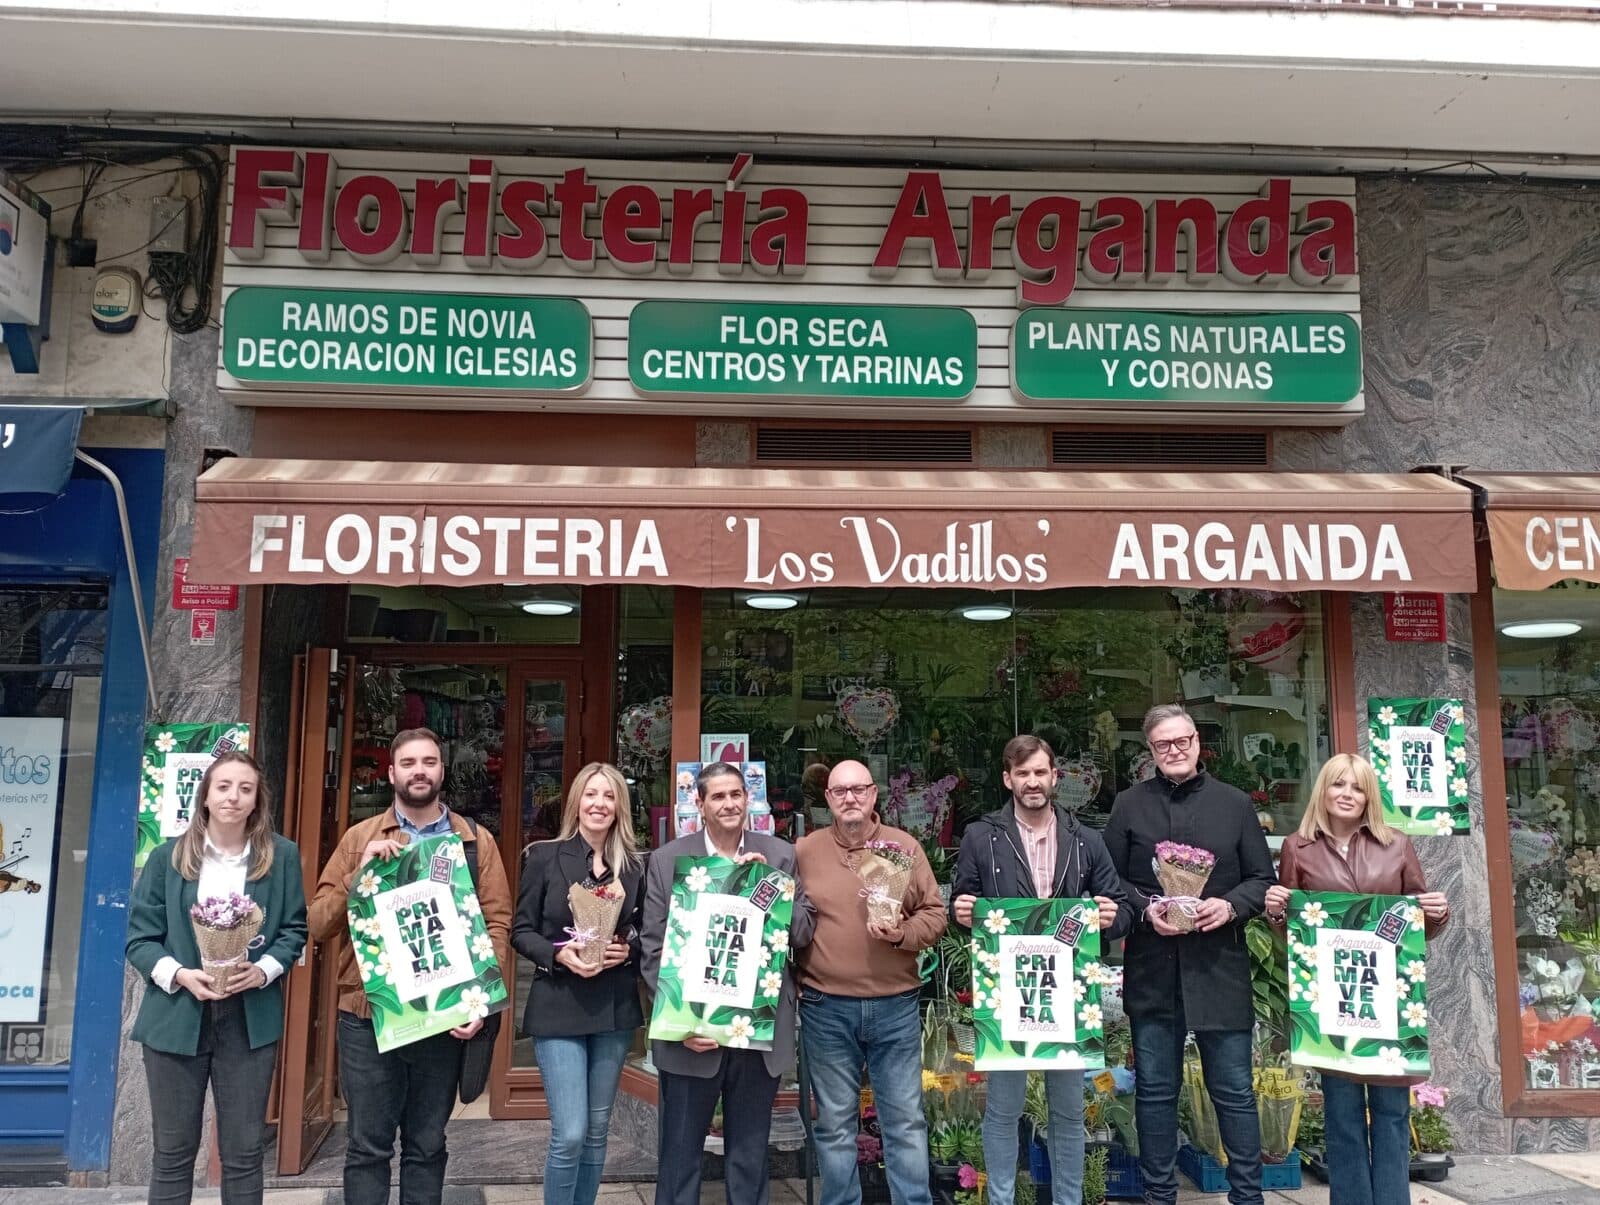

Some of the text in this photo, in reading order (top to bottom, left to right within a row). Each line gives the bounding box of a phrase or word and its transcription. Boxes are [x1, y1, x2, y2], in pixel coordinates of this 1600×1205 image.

[228, 153, 1355, 306] Floristería Arganda
[282, 302, 537, 340] RAMOS DE NOVIA
[721, 315, 889, 348] FLOR SECA
[1028, 322, 1346, 355] PLANTAS NATURALES
[237, 338, 577, 379] DECORACION IGLESIAS
[642, 349, 964, 387] CENTROS Y TARRINAS
[1101, 359, 1274, 390] Y CORONAS
[249, 514, 669, 577] FLORISTERIA
[1108, 523, 1412, 582] ARGANDA
[1393, 596, 1438, 607] Alarma
[1393, 608, 1438, 616] conectada
[1402, 741, 1432, 754] PRI
[0, 746, 51, 784] tos
[1402, 754, 1434, 767] MA
[1406, 767, 1431, 780] VE
[176, 782, 194, 795] M
[1406, 779, 1433, 793] RA
[179, 796, 192, 809] V
[177, 809, 189, 823] R
[395, 898, 439, 925] PRI
[399, 915, 445, 944] MA
[708, 913, 747, 934] PRI
[408, 934, 445, 959] VE
[705, 931, 745, 952] MA
[1009, 941, 1062, 955] Arganda
[1327, 935, 1383, 951] Arganda
[412, 954, 452, 978] RA
[709, 948, 739, 970] VE
[1015, 954, 1056, 971] PRI
[1334, 948, 1377, 968] PRI
[704, 966, 737, 988] RA
[1015, 972, 1057, 988] MA
[1334, 966, 1379, 986] MA
[1020, 989, 1053, 1006] VE
[1338, 983, 1375, 1003] VE
[1020, 1006, 1055, 1024] RA
[1338, 1001, 1377, 1021] RA
